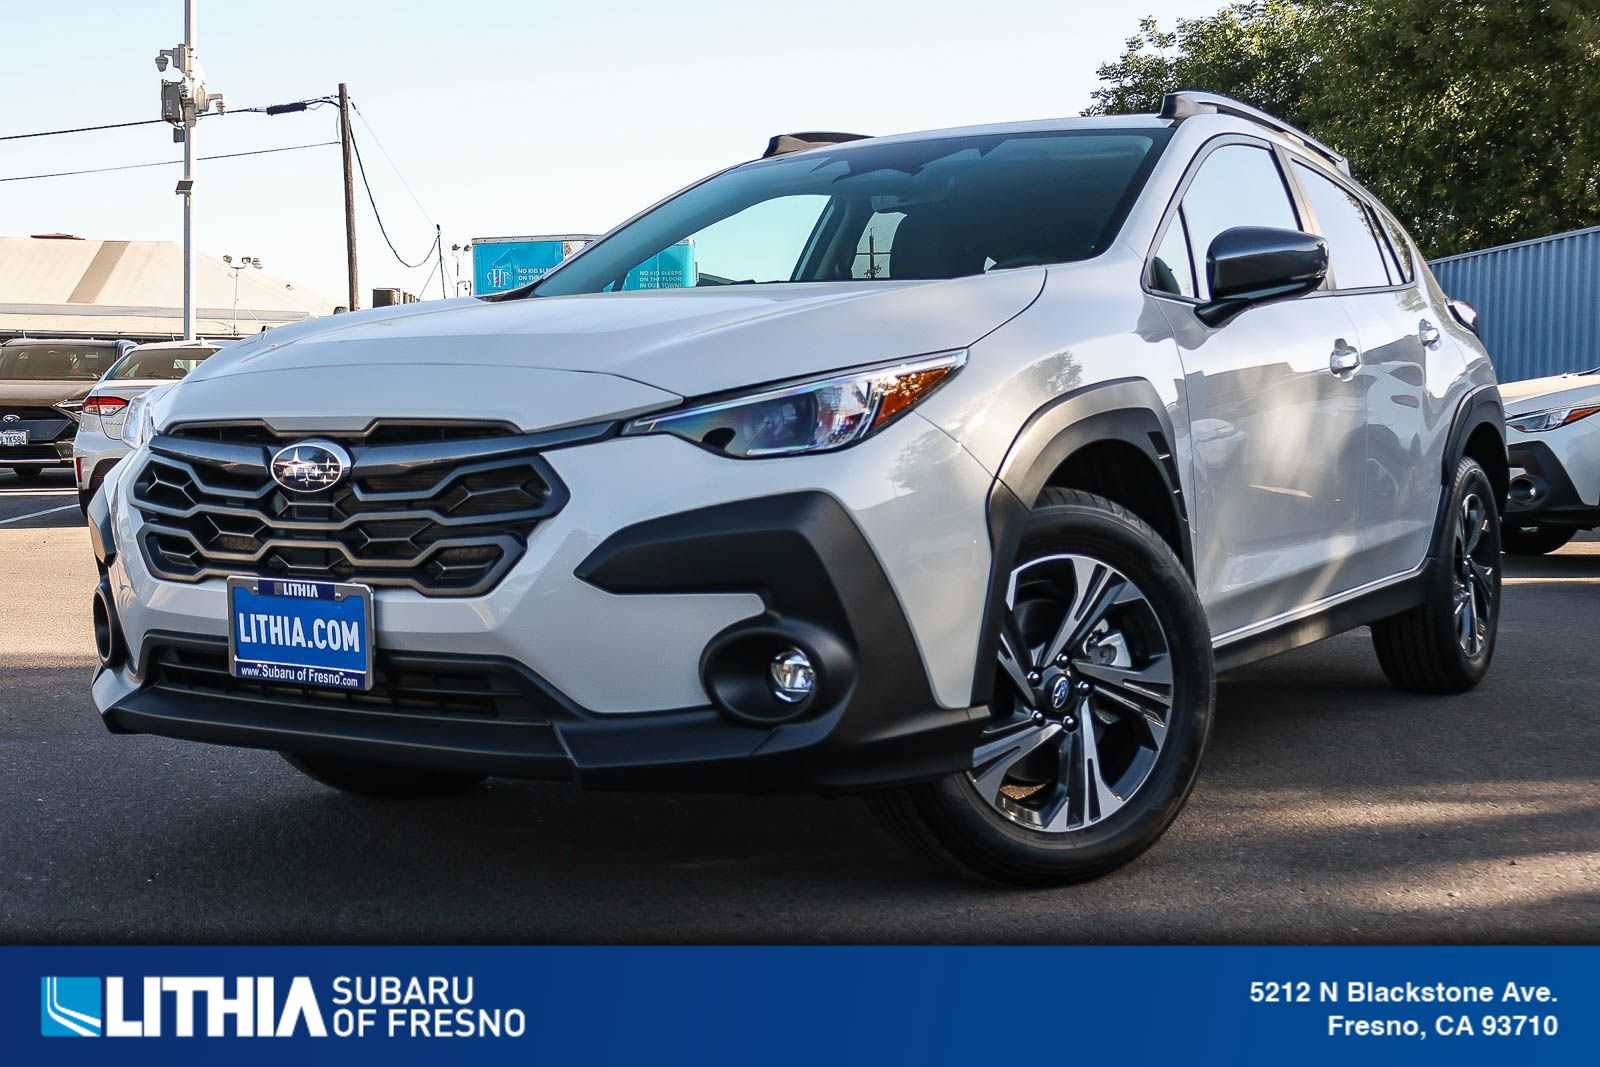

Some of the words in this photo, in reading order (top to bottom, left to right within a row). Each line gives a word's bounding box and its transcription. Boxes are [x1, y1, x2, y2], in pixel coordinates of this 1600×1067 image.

[283, 582, 319, 598] LITHIA
[239, 612, 360, 653] LITHIA.COM
[241, 664, 295, 680] www.Subaru
[297, 669, 307, 681] of
[308, 669, 358, 687] Fresno.com
